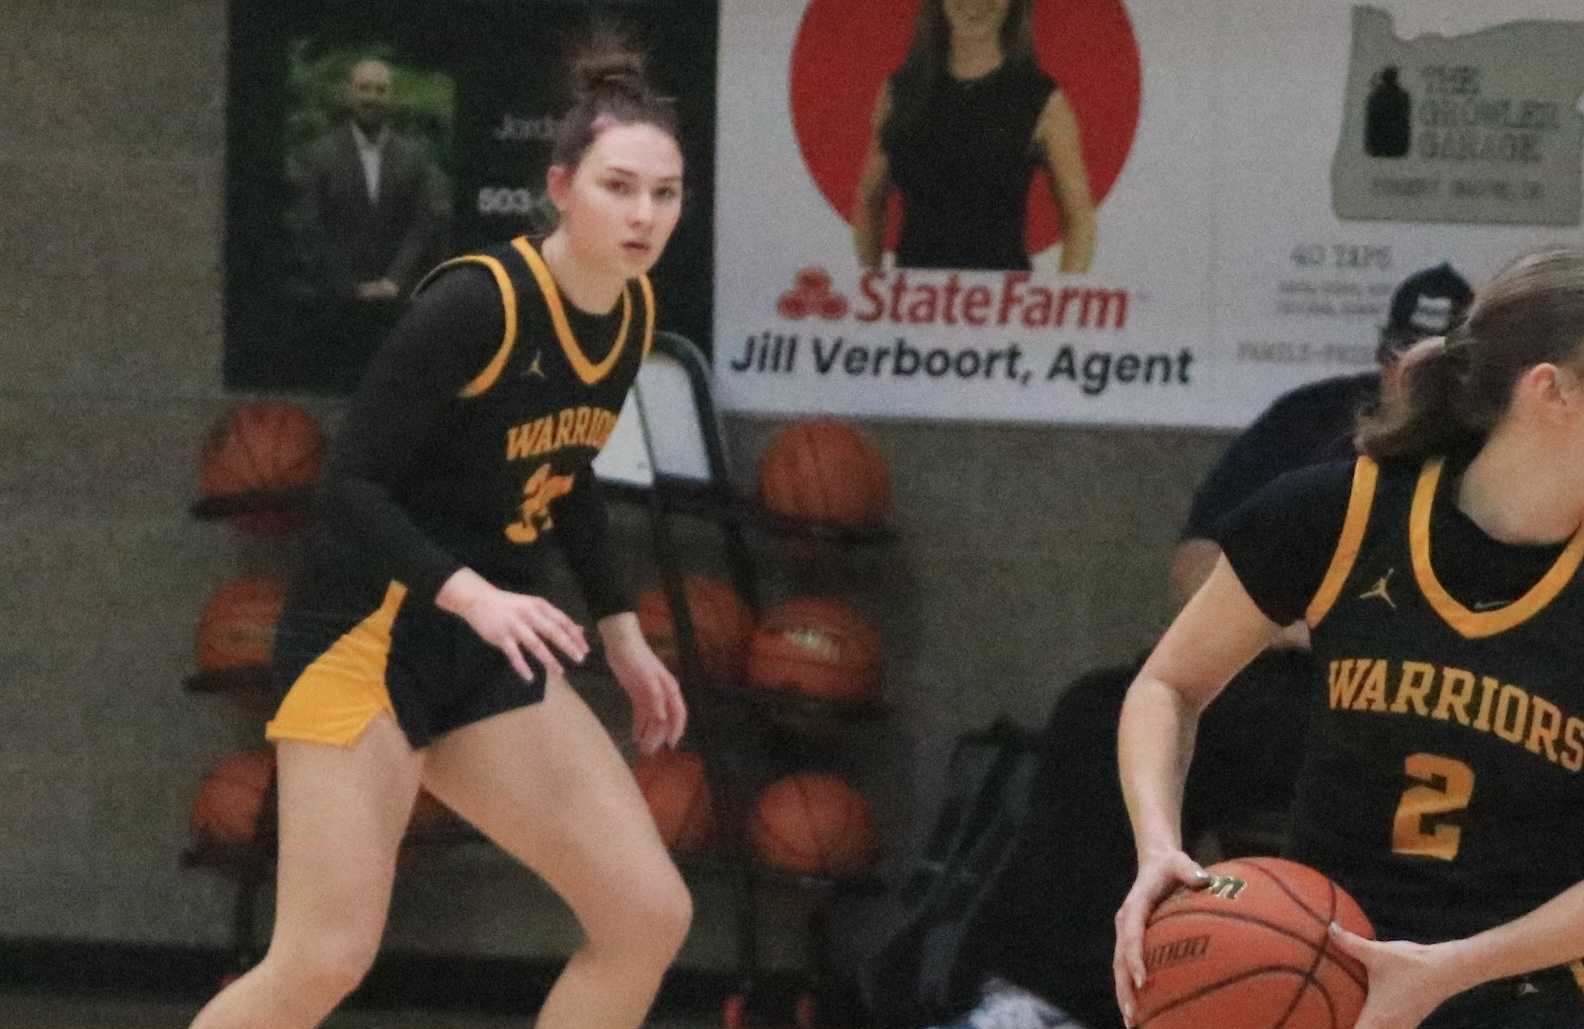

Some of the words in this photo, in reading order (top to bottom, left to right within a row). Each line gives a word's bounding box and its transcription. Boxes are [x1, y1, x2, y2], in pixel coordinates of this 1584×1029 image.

[730, 333, 797, 374] Jill
[811, 336, 1033, 386] Verboort,
[1046, 344, 1195, 397] Agent
[1391, 751, 1477, 862] 2
